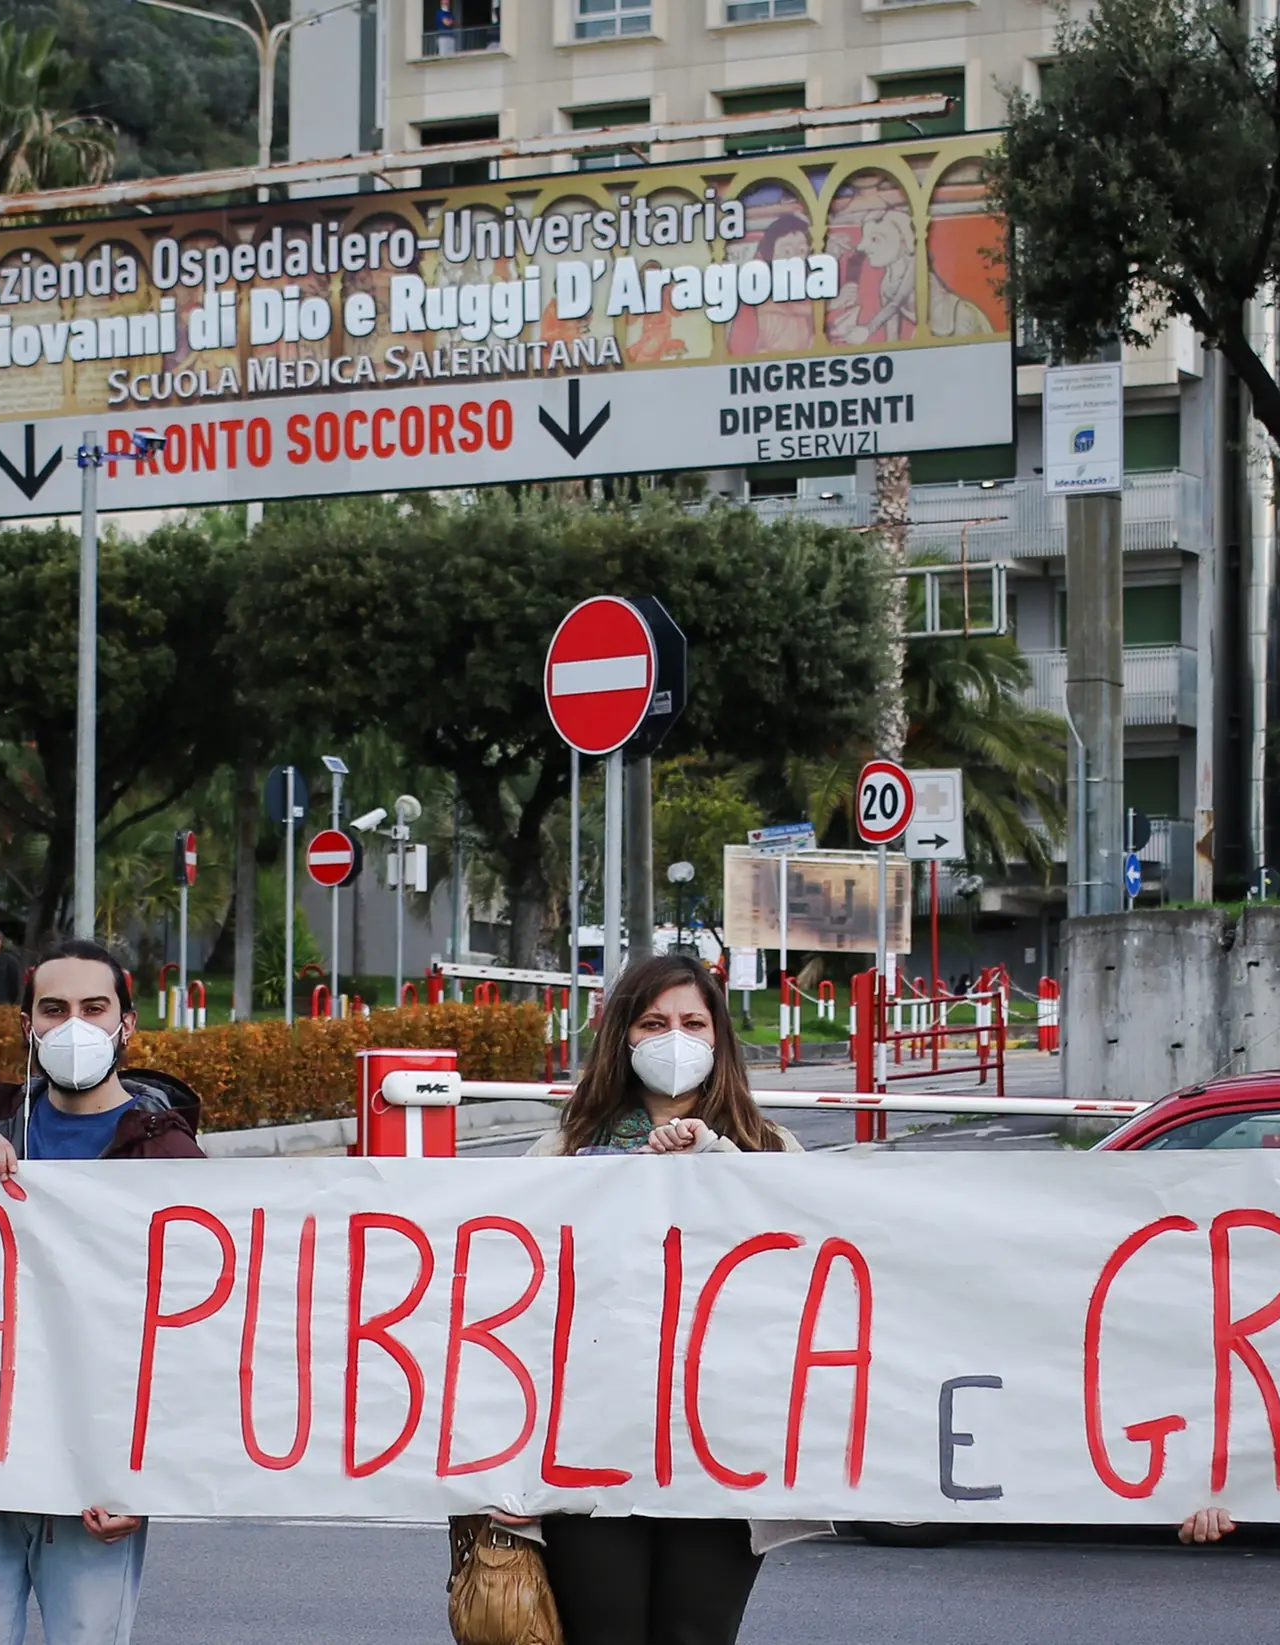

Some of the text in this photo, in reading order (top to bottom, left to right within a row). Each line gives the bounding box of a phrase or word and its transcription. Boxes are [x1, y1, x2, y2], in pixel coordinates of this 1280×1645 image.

[152, 188, 745, 297] Ospedaliero-Universitaria
[187, 290, 237, 352] di
[250, 284, 332, 346] Dio
[343, 292, 377, 338] e
[390, 264, 541, 343] Ruggi
[556, 250, 840, 323] D'Aragona
[107, 334, 623, 404] SCUOLA MEDICA SALERNITANA
[730, 355, 894, 395] INGRESSO
[106, 398, 515, 480] PRONTO SOCCORSO
[719, 394, 915, 437] DIPENDENTI
[756, 430, 880, 461] E SERVIZI
[862, 782, 900, 822] 20
[128, 1204, 874, 1490] PUBBLICA
[938, 1374, 1004, 1501] E
